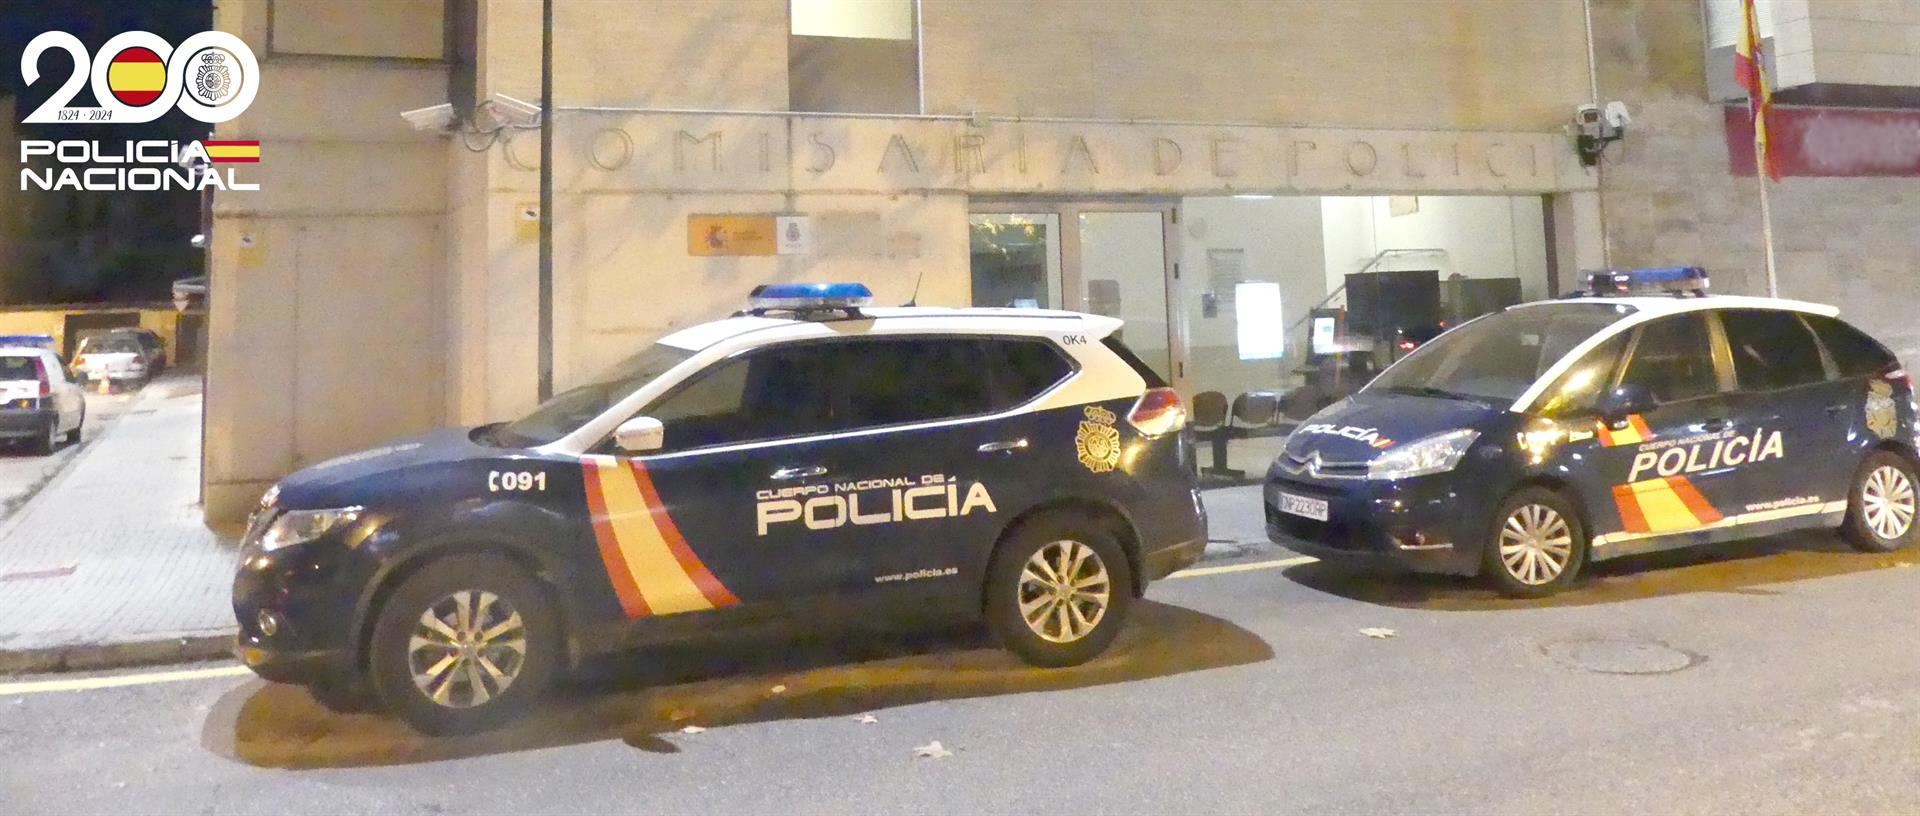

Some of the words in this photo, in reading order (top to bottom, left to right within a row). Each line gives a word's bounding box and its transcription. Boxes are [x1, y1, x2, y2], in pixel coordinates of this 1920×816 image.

[1153, 137, 1237, 178] DE
[501, 471, 546, 491] 091
[756, 484, 829, 500] CUERPO
[834, 476, 916, 492] NACIONAL
[921, 473, 945, 484] DE
[874, 566, 959, 584] www.policia.es
